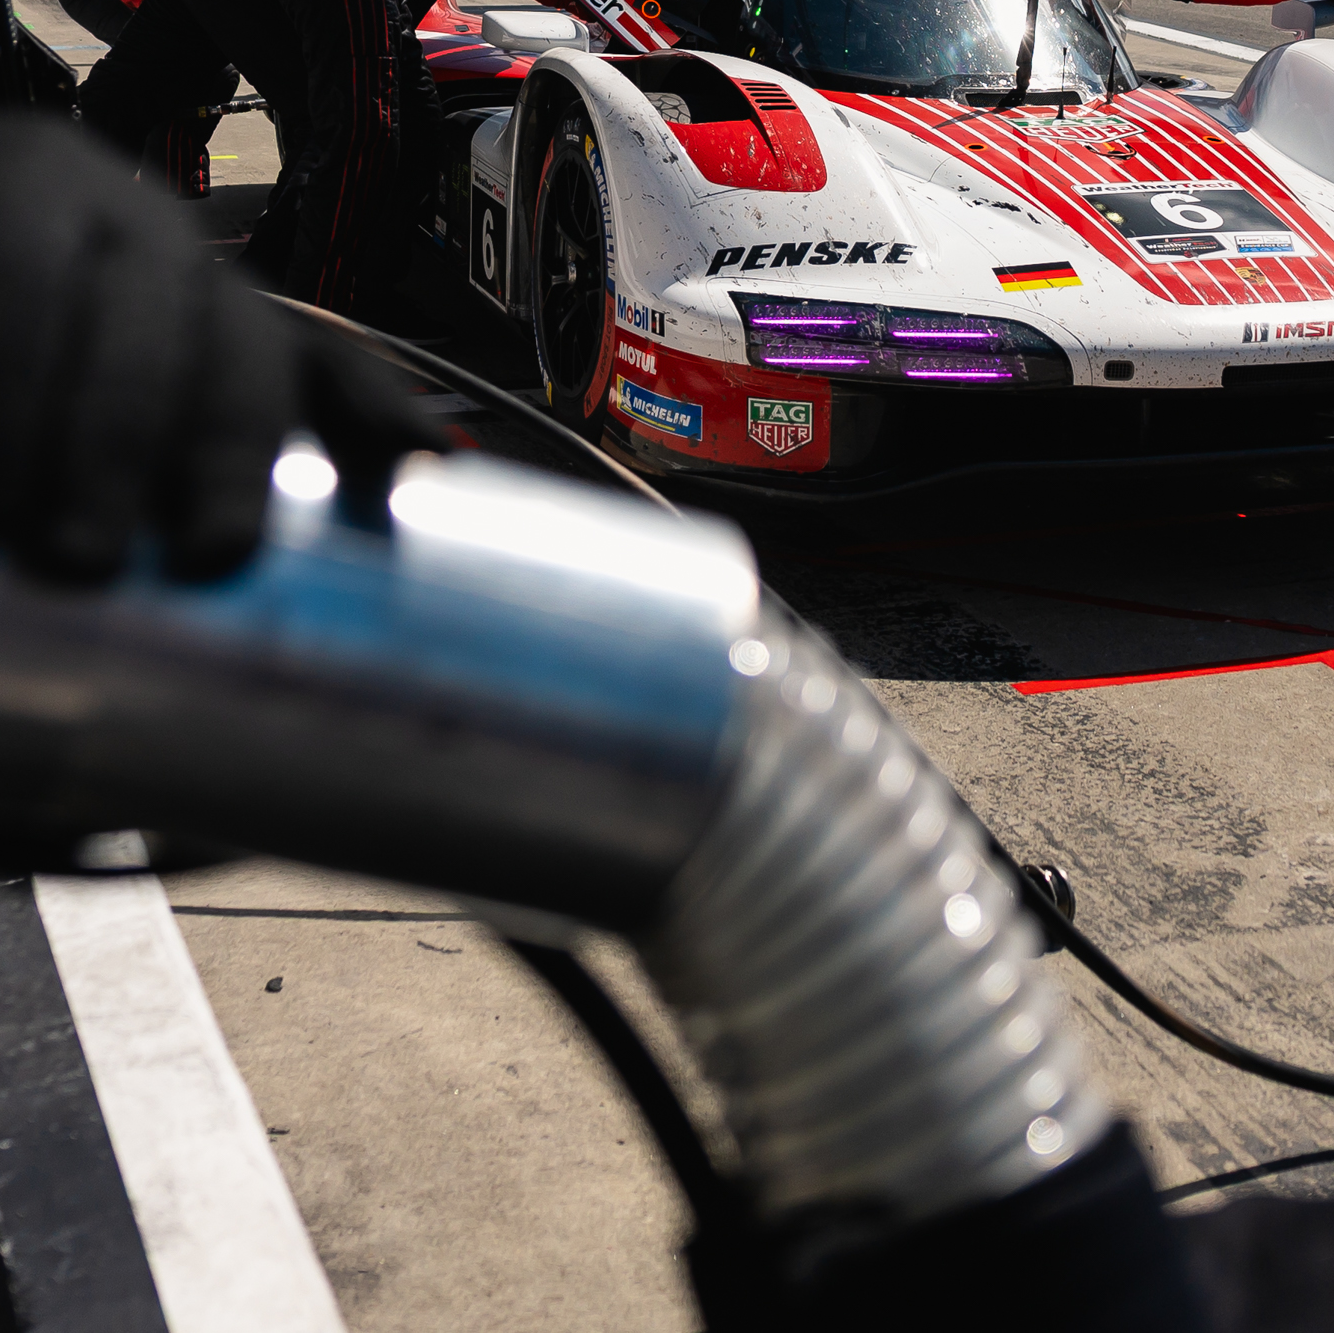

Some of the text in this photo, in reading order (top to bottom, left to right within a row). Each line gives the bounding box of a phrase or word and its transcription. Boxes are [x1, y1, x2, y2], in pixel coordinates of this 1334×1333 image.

[1025, 124, 1135, 141] HEUER
[473, 170, 507, 203] WeatherTech
[1081, 181, 1233, 193] WeatherTech
[592, 167, 616, 282] MICHELIN
[1149, 191, 1224, 231] 6
[482, 207, 496, 282] 6
[706, 240, 918, 277] PENSKE
[617, 293, 649, 332] Mobil
[618, 340, 658, 376] MOTUL
[632, 395, 692, 428] MICHELIN
[753, 402, 807, 423] TAG
[751, 423, 808, 452] HEUER
